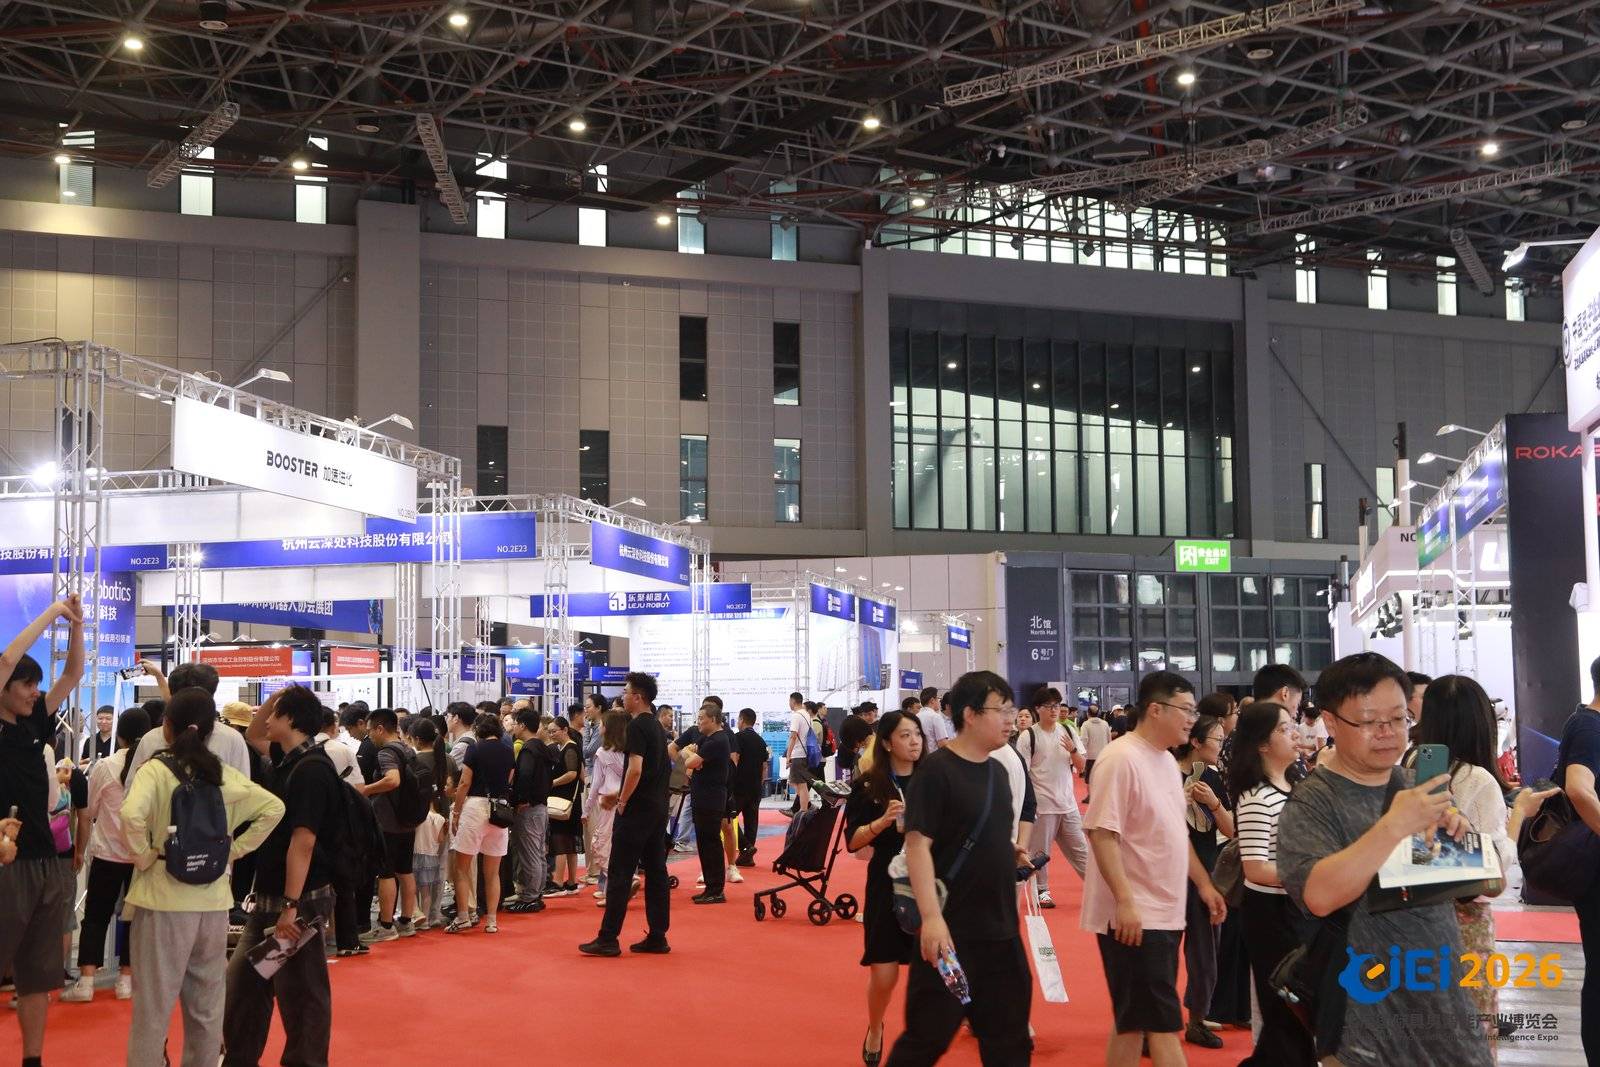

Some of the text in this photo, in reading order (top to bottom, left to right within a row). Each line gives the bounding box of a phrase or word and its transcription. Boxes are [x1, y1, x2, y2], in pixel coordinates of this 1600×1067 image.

[266, 450, 319, 479] BOOSTER
[496, 545, 528, 553] NO.2E23
[130, 557, 160, 565] NO.2E23
[628, 601, 671, 609] LEJU ROBOT
[1030, 616, 1052, 629] 北馆
